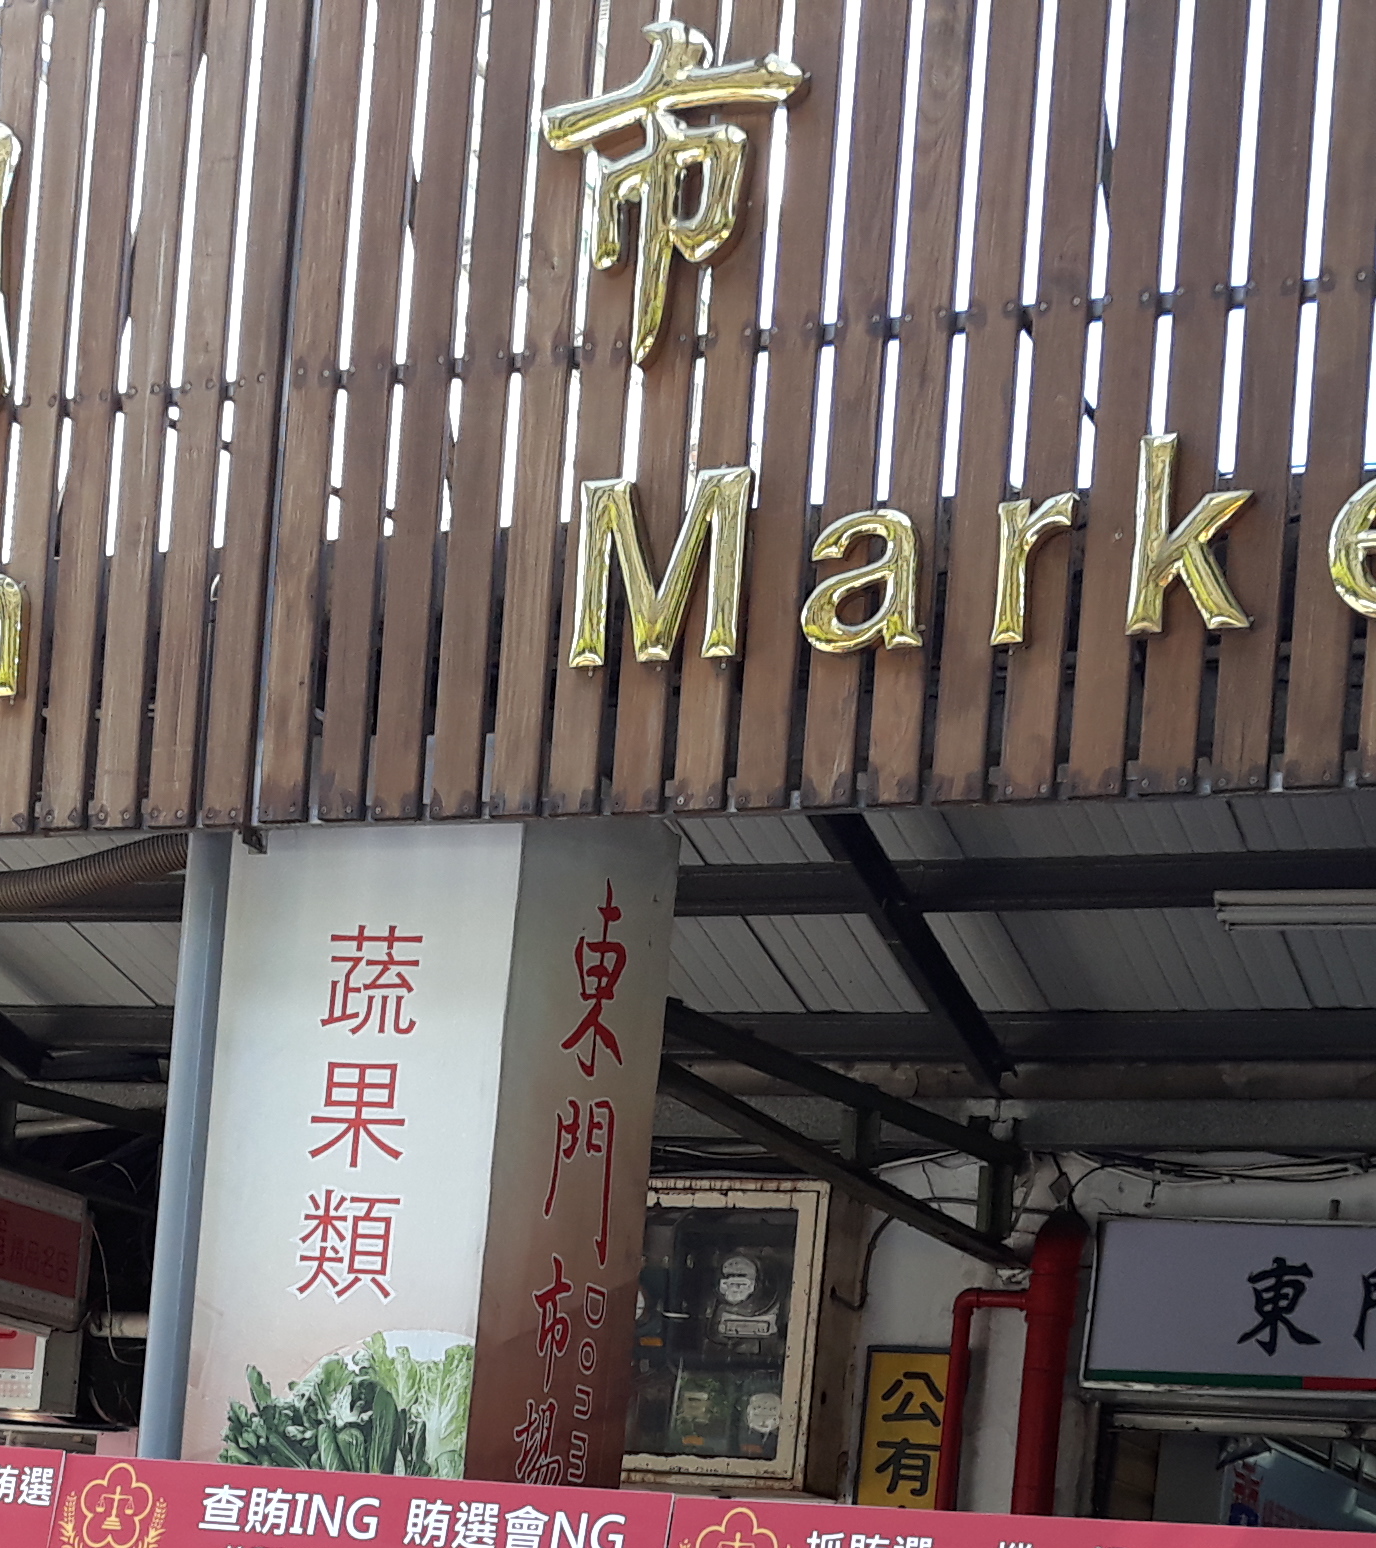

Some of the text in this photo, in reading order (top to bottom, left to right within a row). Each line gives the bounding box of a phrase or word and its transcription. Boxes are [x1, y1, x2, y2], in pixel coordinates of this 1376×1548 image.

[293, 923, 425, 1305] 蔬果類
[567, 1282, 609, 1483] Donm
[875, 1371, 945, 1498] 公有
[198, 1484, 380, 1540] 查賄ING
